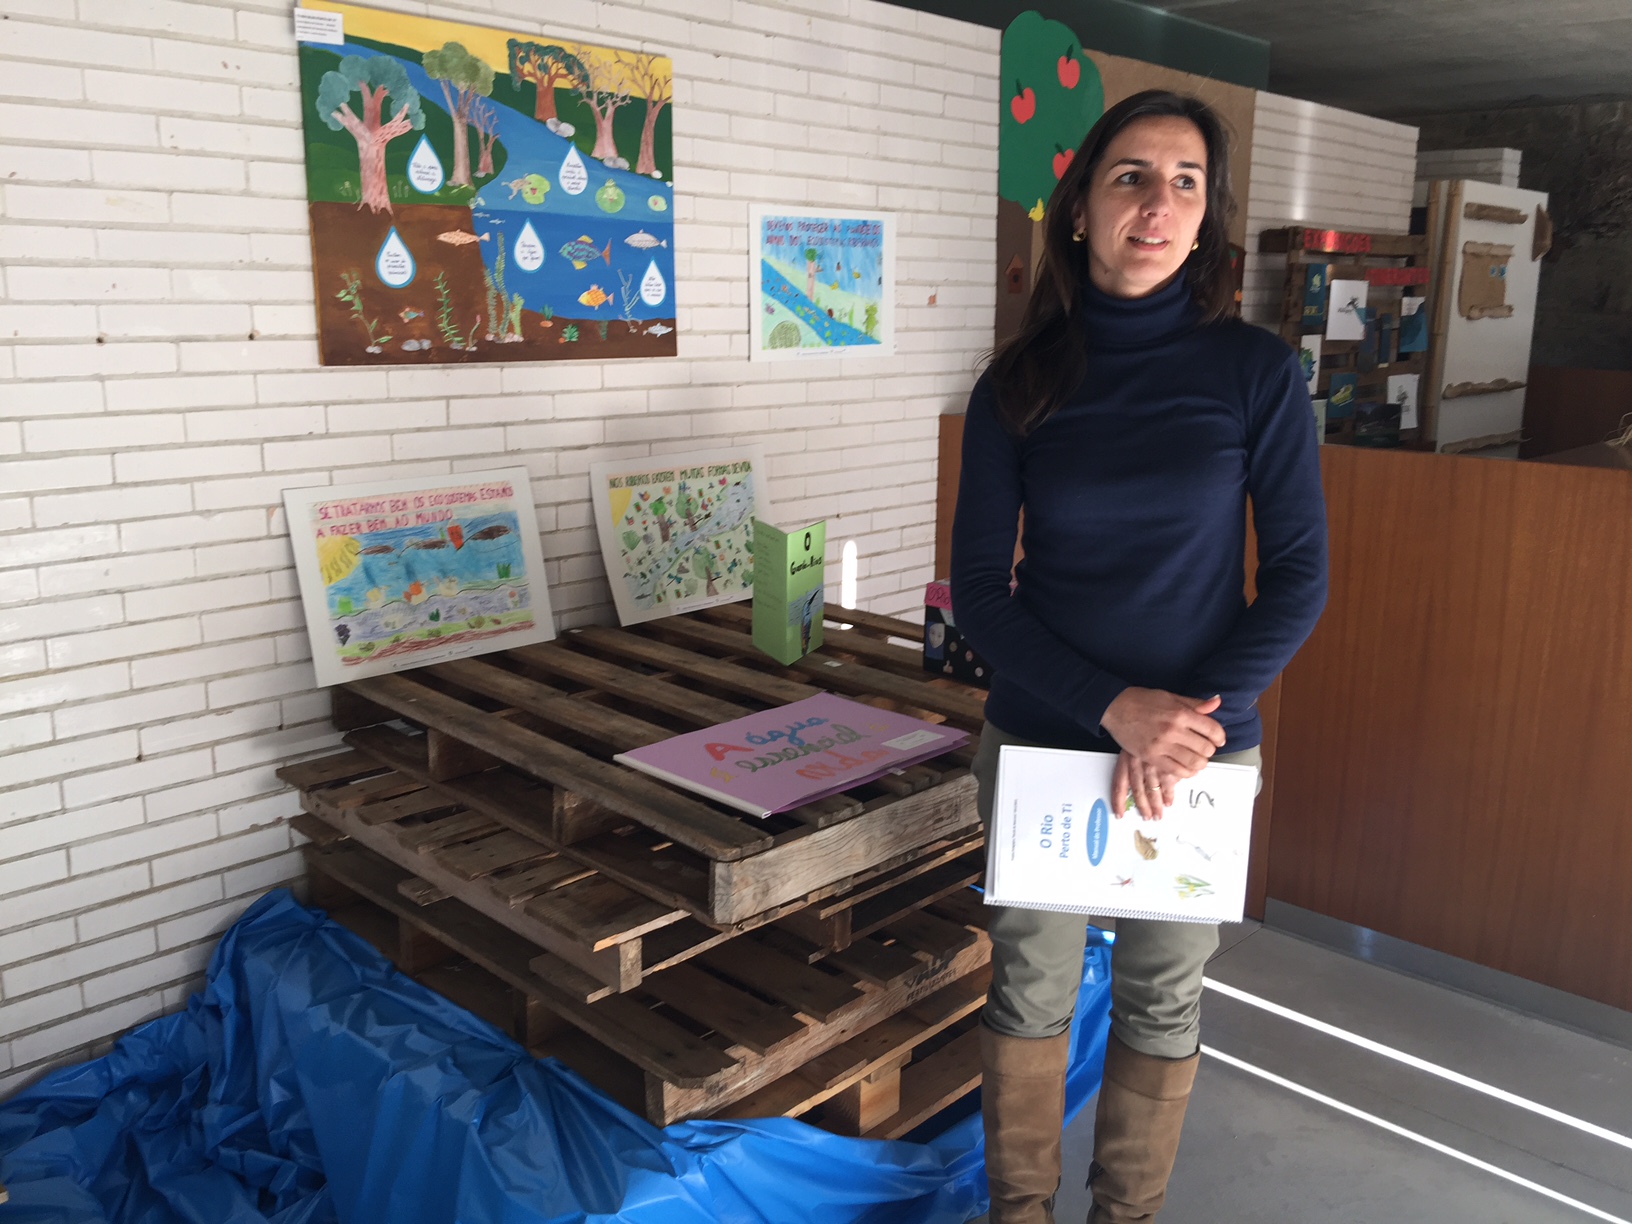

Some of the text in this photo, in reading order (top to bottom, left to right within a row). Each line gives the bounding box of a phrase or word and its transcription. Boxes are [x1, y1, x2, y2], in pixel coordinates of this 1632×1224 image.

[389, 499, 408, 514] BEM
[414, 496, 424, 509] OS
[316, 528, 325, 538] A
[330, 522, 362, 536] FAZER
[367, 518, 388, 532] BEM
[416, 509, 454, 524] MUNDO
[804, 532, 812, 551] O
[704, 716, 830, 761] A água
[1039, 814, 1054, 849] O Rio
[1058, 802, 1072, 859] Perto de Ti
[1094, 808, 1102, 832] Professor
[1092, 840, 1100, 860] Manual
